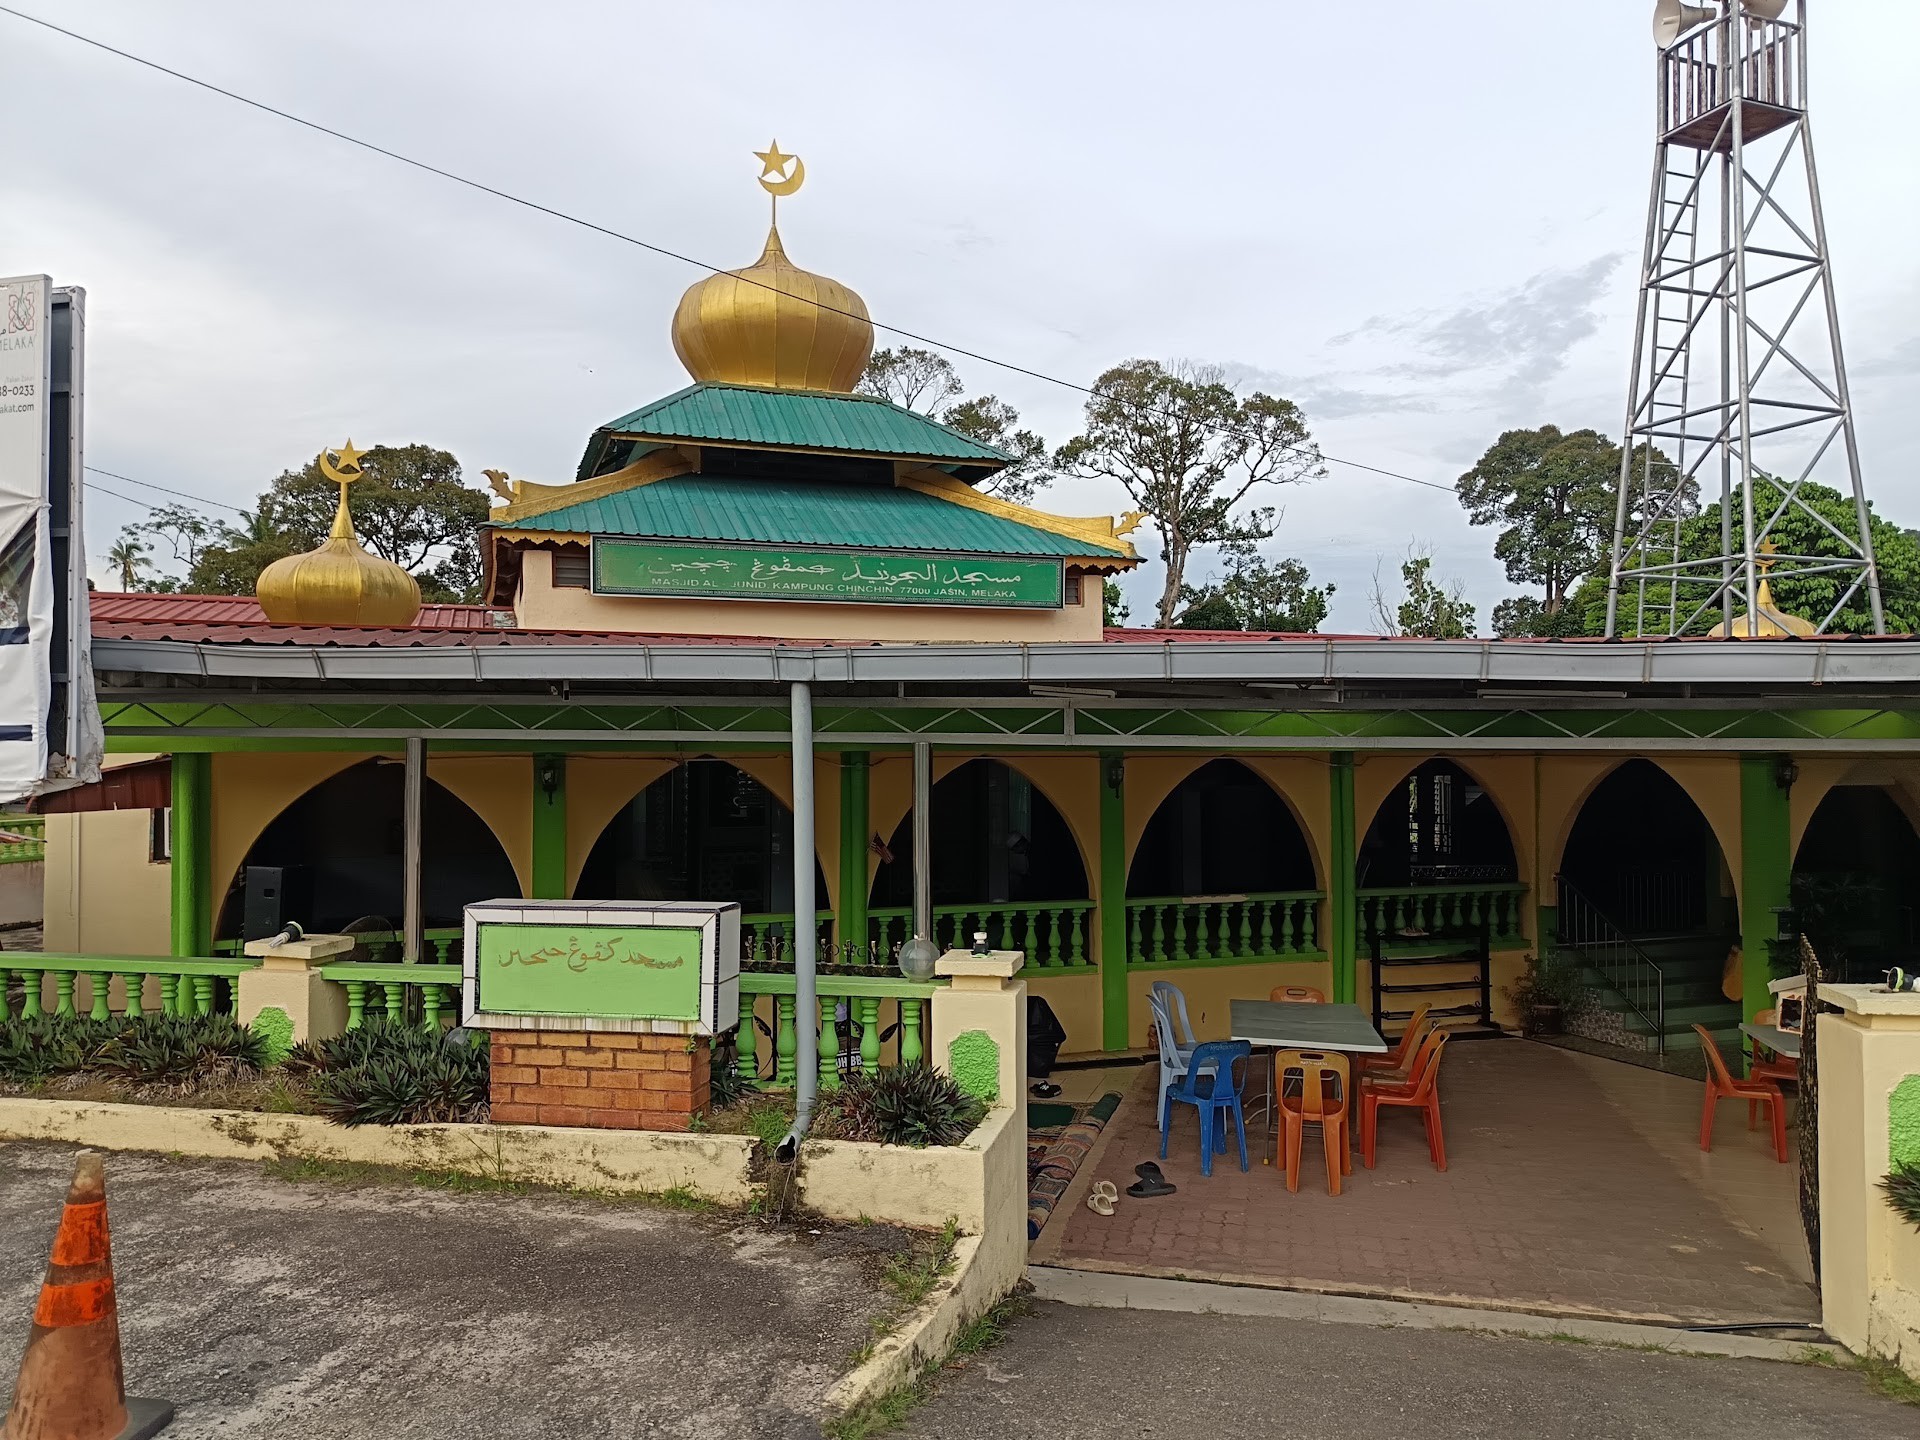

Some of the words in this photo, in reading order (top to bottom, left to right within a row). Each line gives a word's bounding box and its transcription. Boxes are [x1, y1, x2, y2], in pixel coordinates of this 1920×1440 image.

[942, 566, 1021, 586] مسجد
[651, 577, 699, 587] MASJID
[703, 579, 718, 588] AL
[773, 581, 834, 592] KAMPUNG
[837, 583, 893, 593] CHINCHIN
[971, 589, 1017, 598] MELAKA
